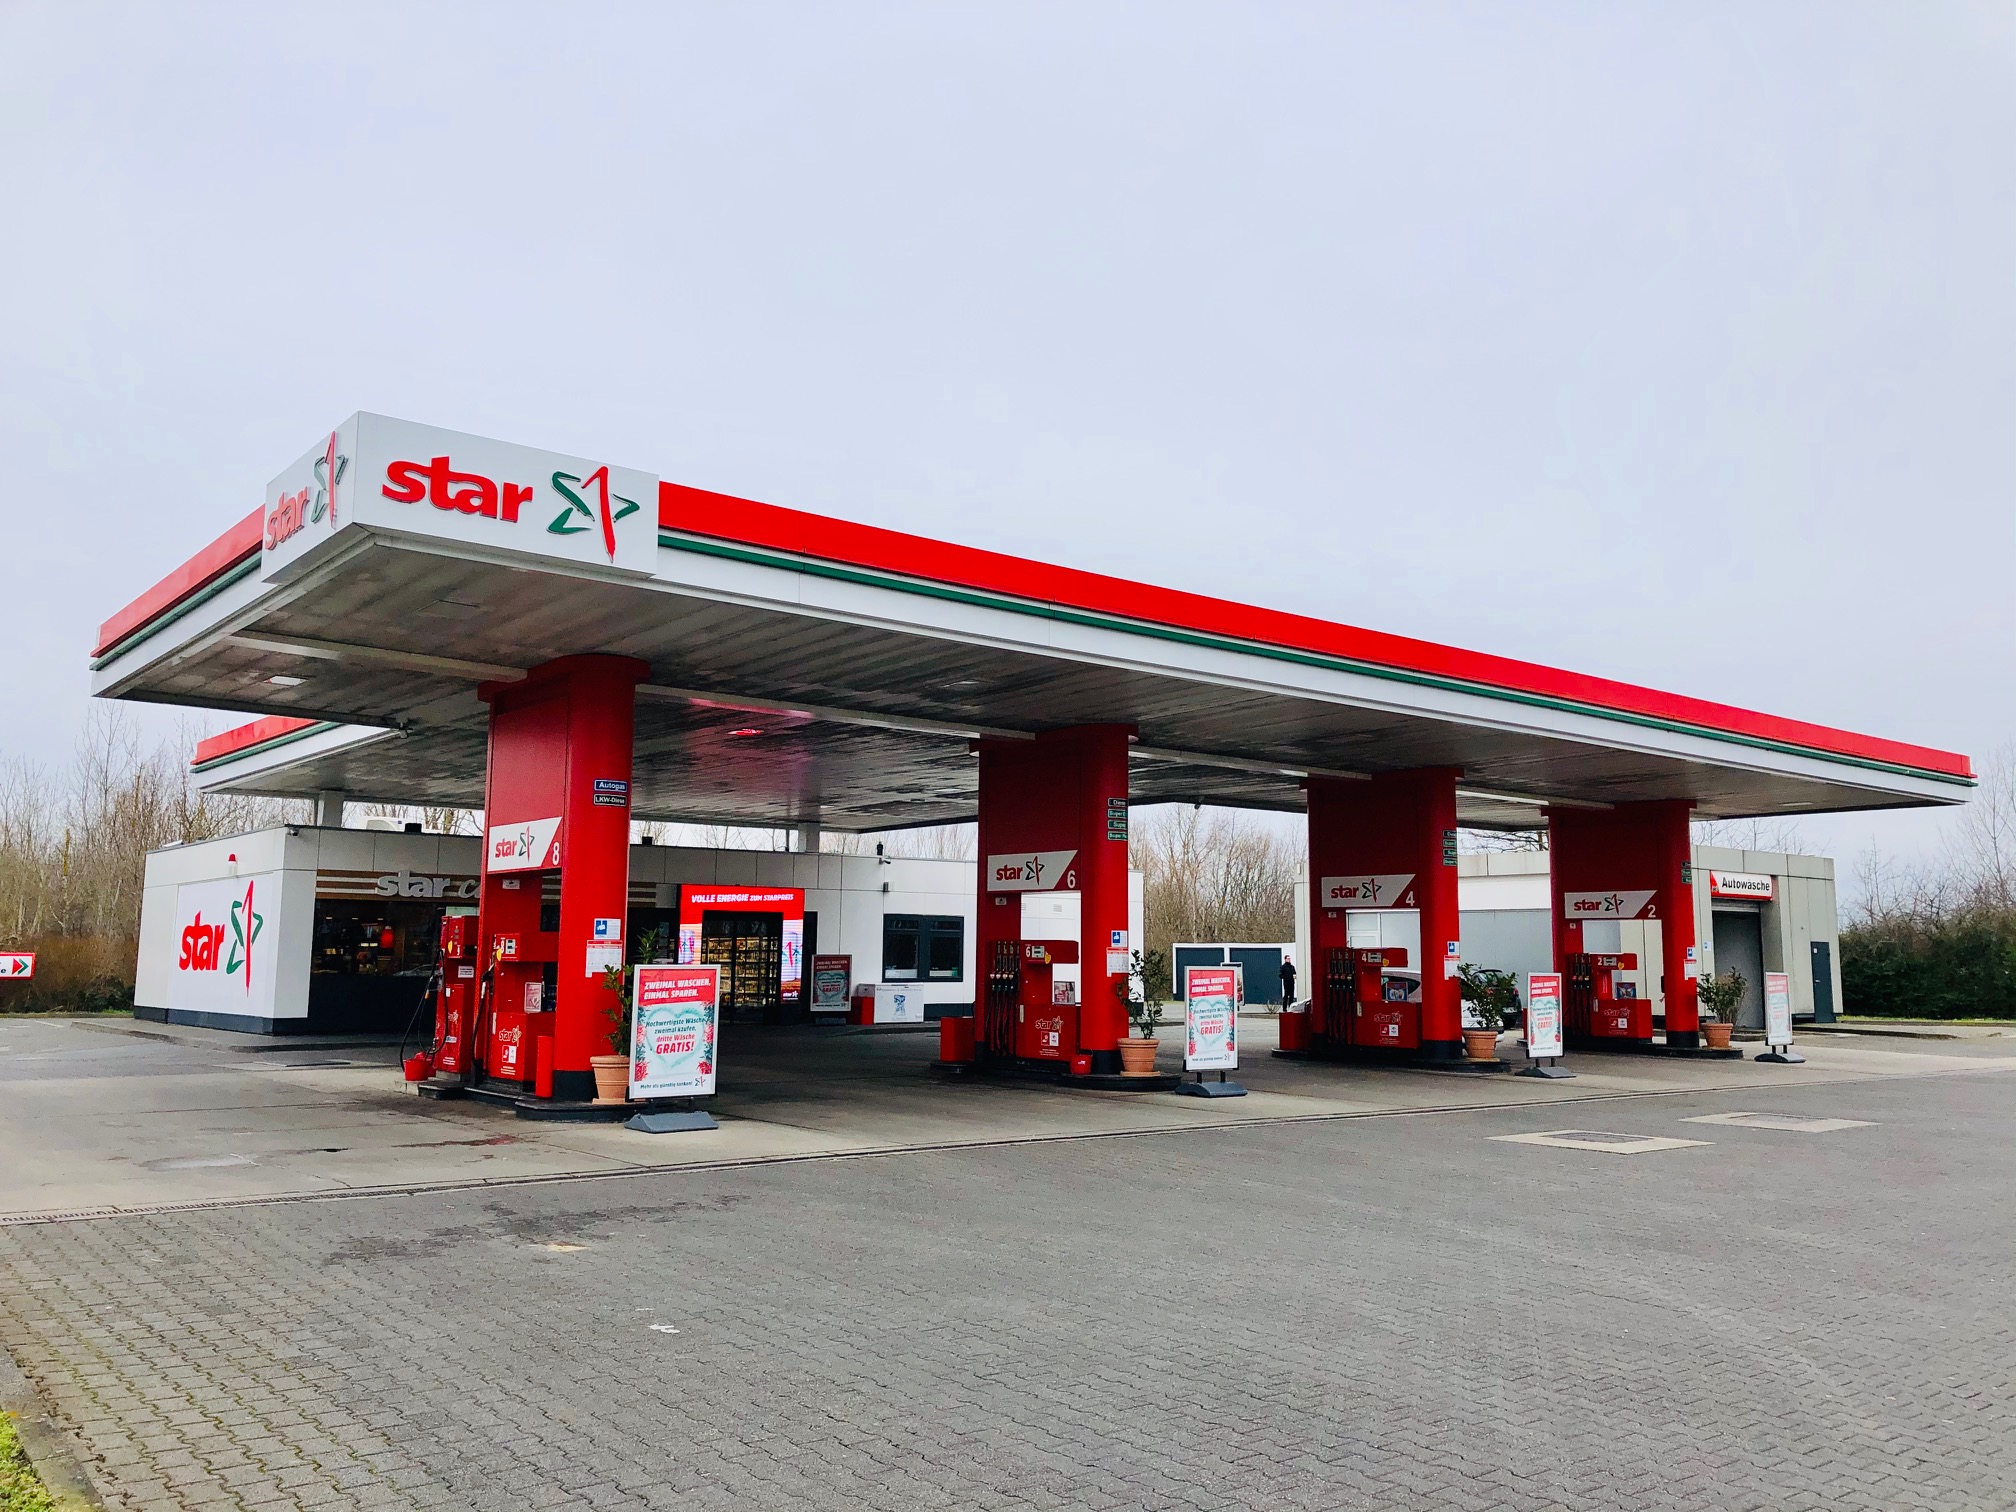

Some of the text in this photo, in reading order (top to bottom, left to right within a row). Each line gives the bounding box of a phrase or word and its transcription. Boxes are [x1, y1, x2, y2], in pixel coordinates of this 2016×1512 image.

[381, 456, 534, 524] star
[266, 485, 310, 551] star
[599, 781, 626, 791] Autogas
[495, 838, 518, 859] star
[552, 842, 560, 866] 8
[996, 864, 1023, 881] star
[1067, 870, 1076, 889] 6
[376, 870, 450, 898] star
[1721, 876, 1770, 892] Autowäsche
[691, 894, 716, 903] VOLLE
[716, 893, 750, 903] ENERGIE
[750, 894, 763, 902] ZUM
[1330, 884, 1359, 899] star
[1405, 891, 1415, 907] 4
[1573, 899, 1602, 911] star
[1647, 905, 1657, 918] 2
[179, 910, 225, 971] star
[1025, 946, 1031, 958] 6
[644, 978, 711, 990] ZWEIMAL WASCHEN,
[643, 988, 699, 1000] EINMAL SPAREN.
[654, 1026, 677, 1035] zweimal
[1035, 1018, 1053, 1030] star
[1200, 1025, 1224, 1036] GRATIS!
[498, 1028, 513, 1042] star
[656, 1033, 695, 1043] dritte Wäsche
[656, 1041, 695, 1055] GRATIS!
